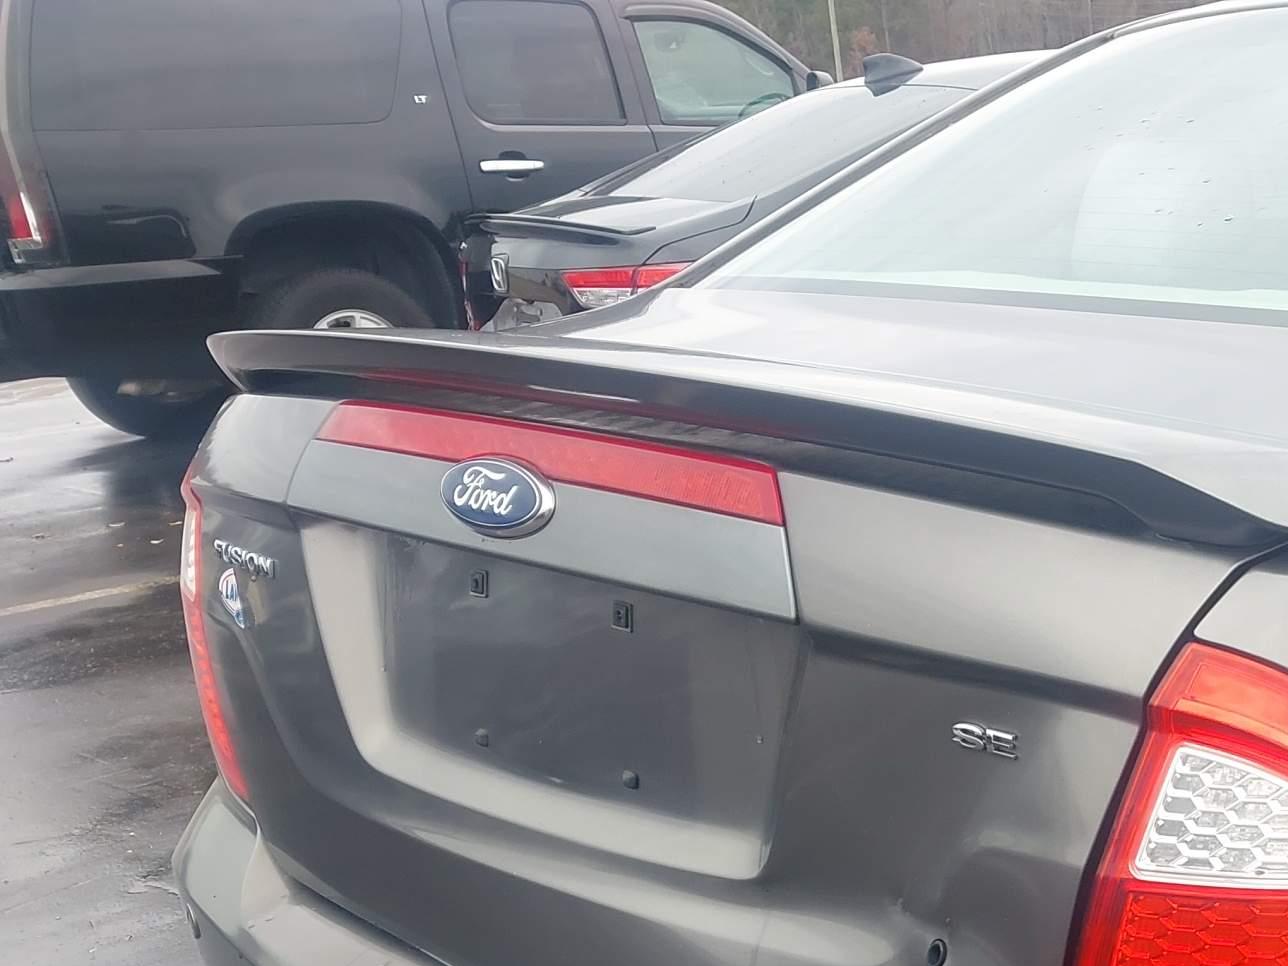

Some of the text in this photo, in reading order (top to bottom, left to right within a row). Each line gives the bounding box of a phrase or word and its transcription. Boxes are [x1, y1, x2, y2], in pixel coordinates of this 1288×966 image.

[414, 95, 428, 104] LT
[454, 466, 519, 515] Ford
[214, 539, 276, 578] FUSION
[952, 722, 1018, 760] SE
